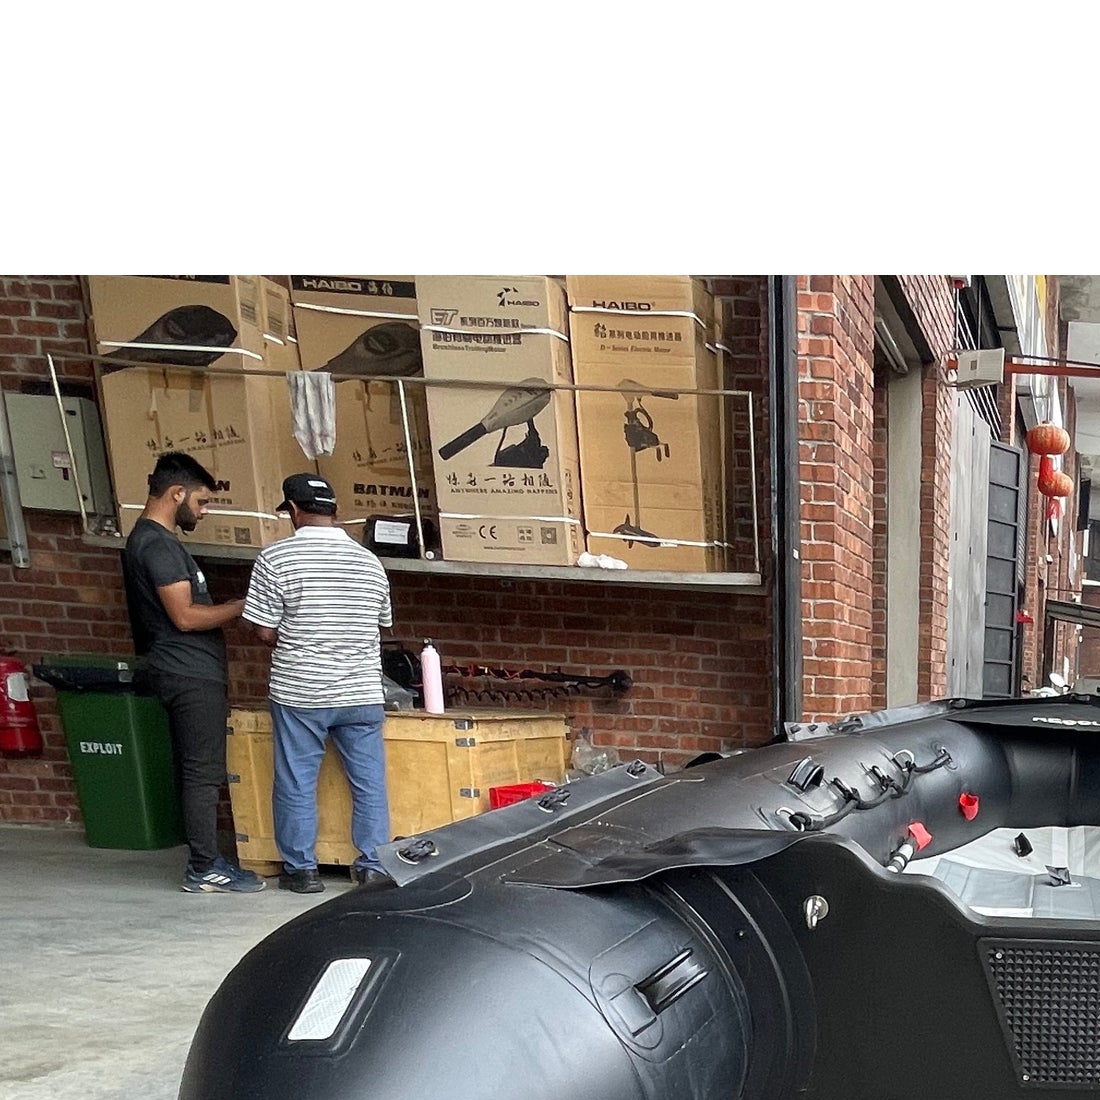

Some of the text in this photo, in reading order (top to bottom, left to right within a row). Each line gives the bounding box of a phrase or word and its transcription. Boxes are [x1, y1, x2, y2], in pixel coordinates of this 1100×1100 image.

[303, 278, 362, 292] HAIBO
[593, 300, 652, 312] HAIBO
[80, 741, 123, 755] EXPLOIT
